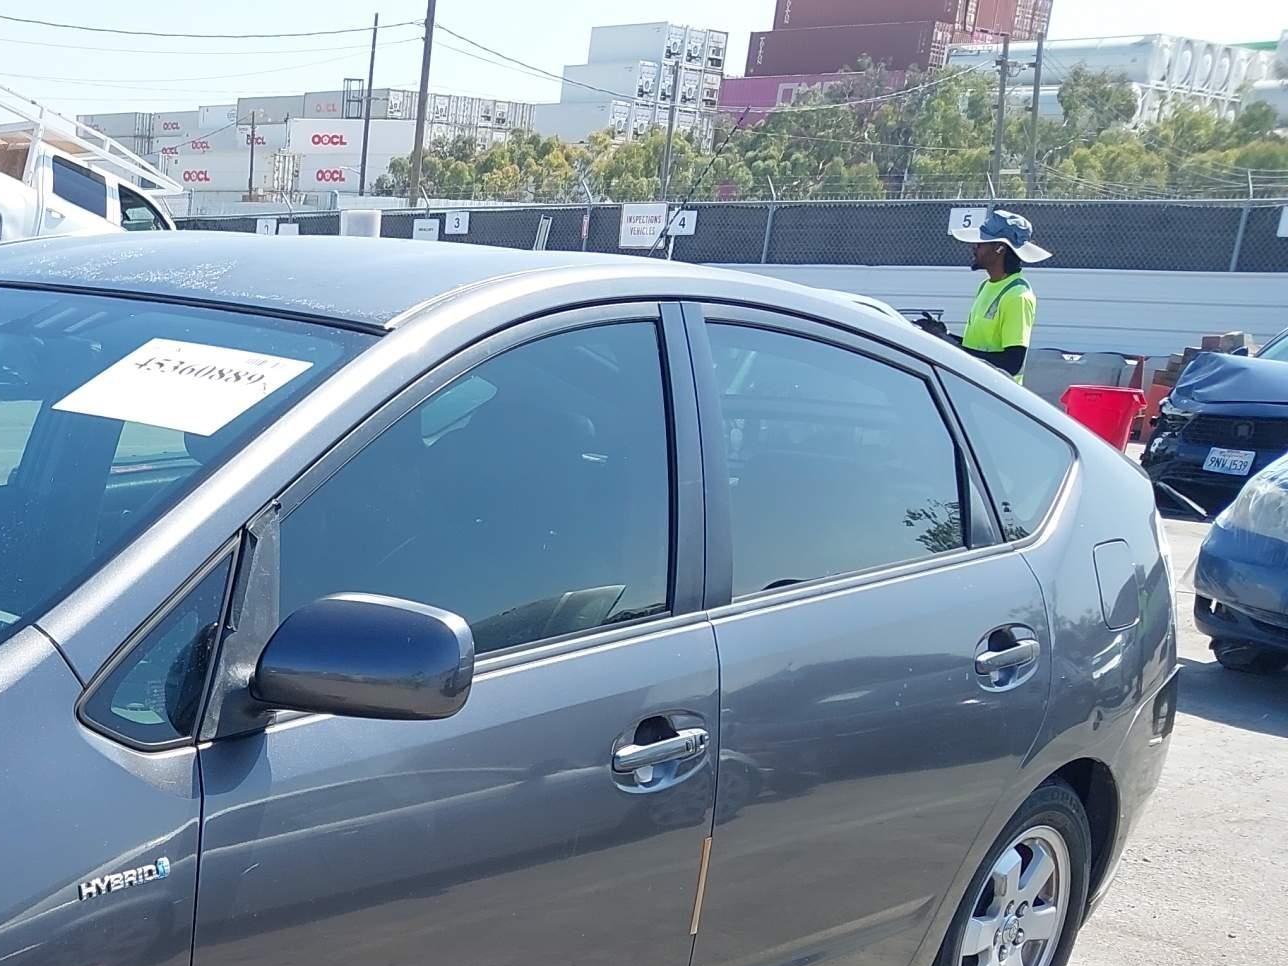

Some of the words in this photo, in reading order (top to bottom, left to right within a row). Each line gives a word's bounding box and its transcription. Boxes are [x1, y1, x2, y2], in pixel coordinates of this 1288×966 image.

[312, 134, 347, 146] OOCL
[183, 170, 210, 182] OOCL
[316, 169, 345, 182] OOCL
[453, 217, 461, 229] 3
[626, 215, 663, 225] INSPECTIONS
[678, 216, 686, 229] 4
[962, 214, 972, 228] 5
[630, 226, 656, 236] VEHICLES
[134, 356, 265, 385] 45360889
[78, 864, 160, 901] HYBRID
